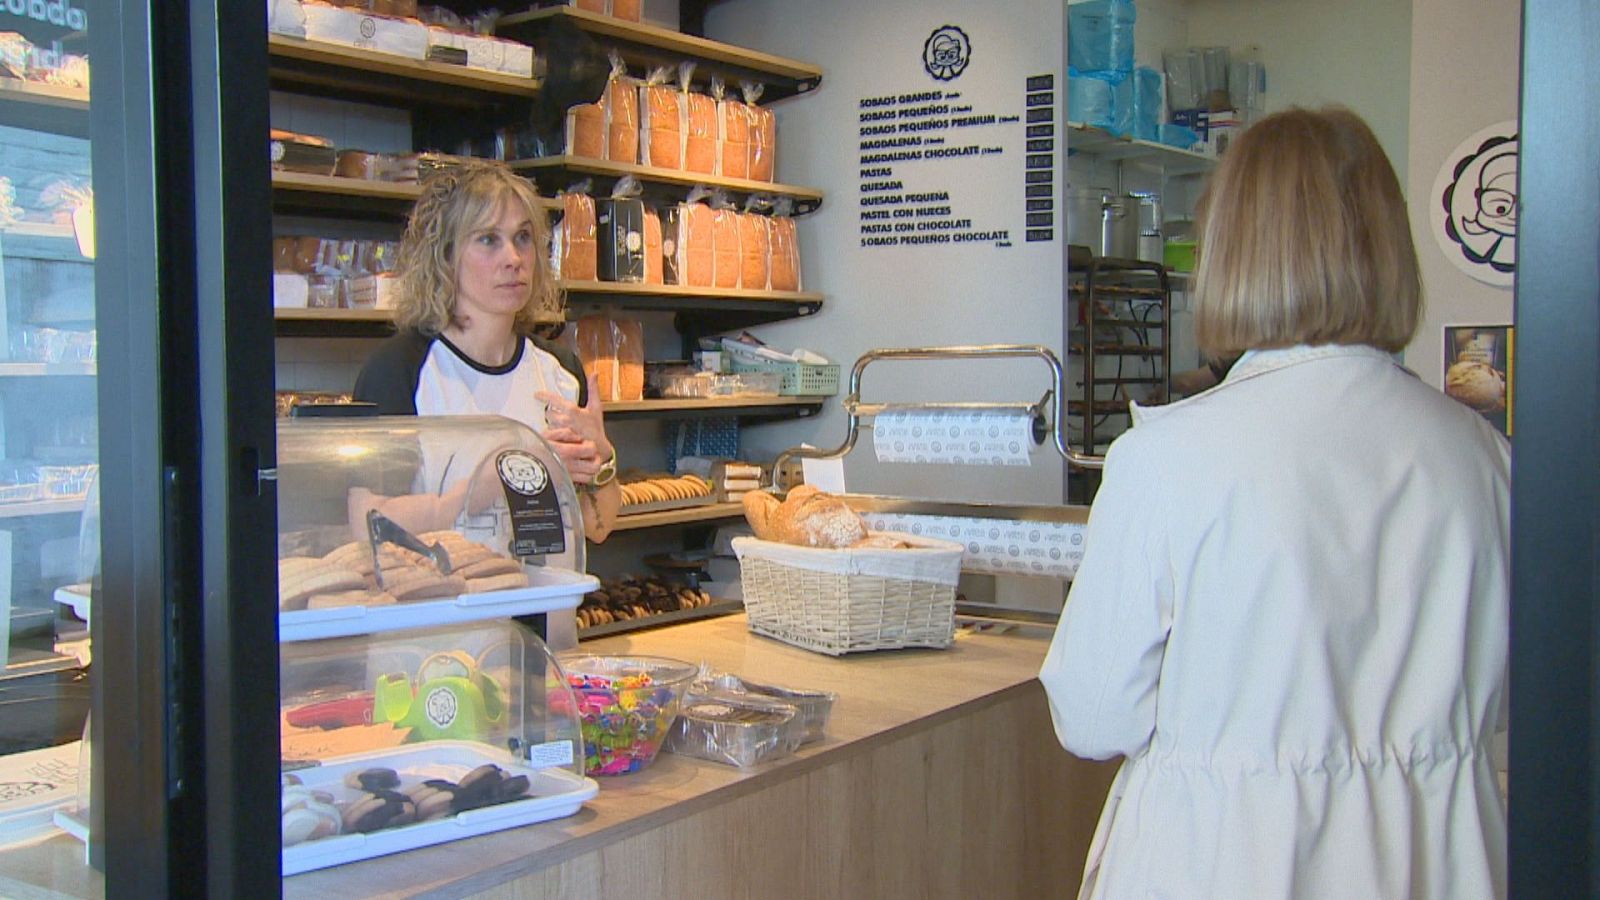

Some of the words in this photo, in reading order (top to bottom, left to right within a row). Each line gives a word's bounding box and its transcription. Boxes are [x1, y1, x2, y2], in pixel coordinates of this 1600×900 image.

[860, 96, 896, 108] SOBAOS
[899, 91, 942, 103] GRANDES
[860, 111, 896, 122] SOBAOS
[899, 105, 948, 119] PEQUEÑOS
[860, 125, 896, 136] SOBAOS
[899, 118, 948, 133] PEQUEÑOS
[951, 115, 995, 127] PREMIUM
[860, 137, 922, 150] MAGDALENAS
[860, 151, 922, 164] MAGDALENAS
[924, 146, 979, 158] CHOCOLATE
[860, 168, 892, 178] PASTAS
[860, 181, 903, 192] QUESADA
[860, 195, 903, 206] QUESADA
[860, 210, 890, 220] PASTEL
[893, 209, 913, 218] CON
[916, 206, 951, 217] NUECES
[861, 223, 892, 234] PASTAS
[895, 223, 915, 232] CON
[917, 219, 971, 231] CHOCOLATE
[861, 236, 898, 246] SOBAOS
[953, 231, 1009, 242] CHOCOLATE
